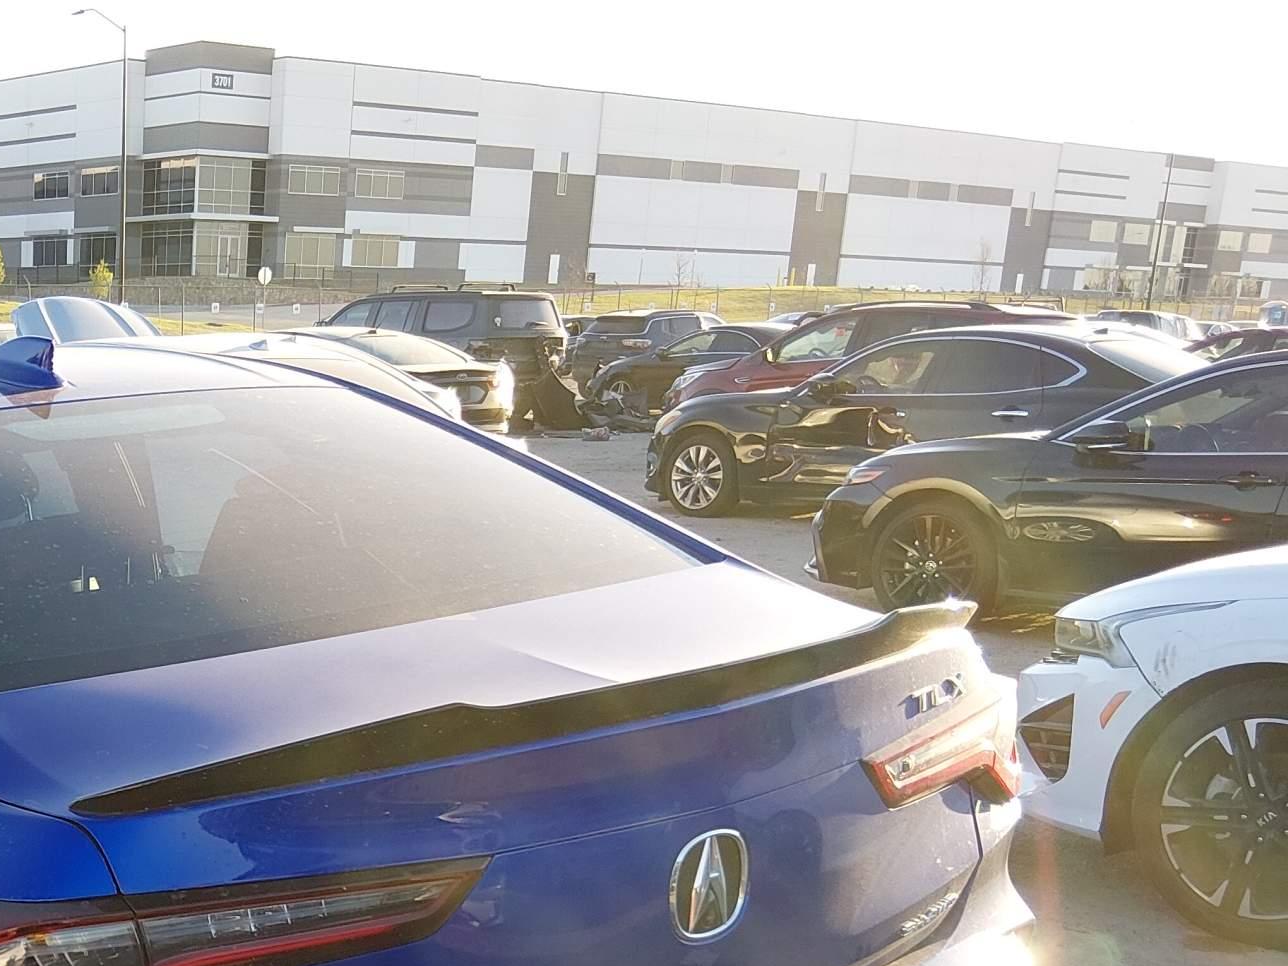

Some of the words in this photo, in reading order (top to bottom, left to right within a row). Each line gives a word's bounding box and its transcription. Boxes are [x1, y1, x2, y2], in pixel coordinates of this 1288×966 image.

[213, 76, 231, 88] 3701
[911, 673, 967, 713] TLX
[1257, 811, 1277, 827] KIA
